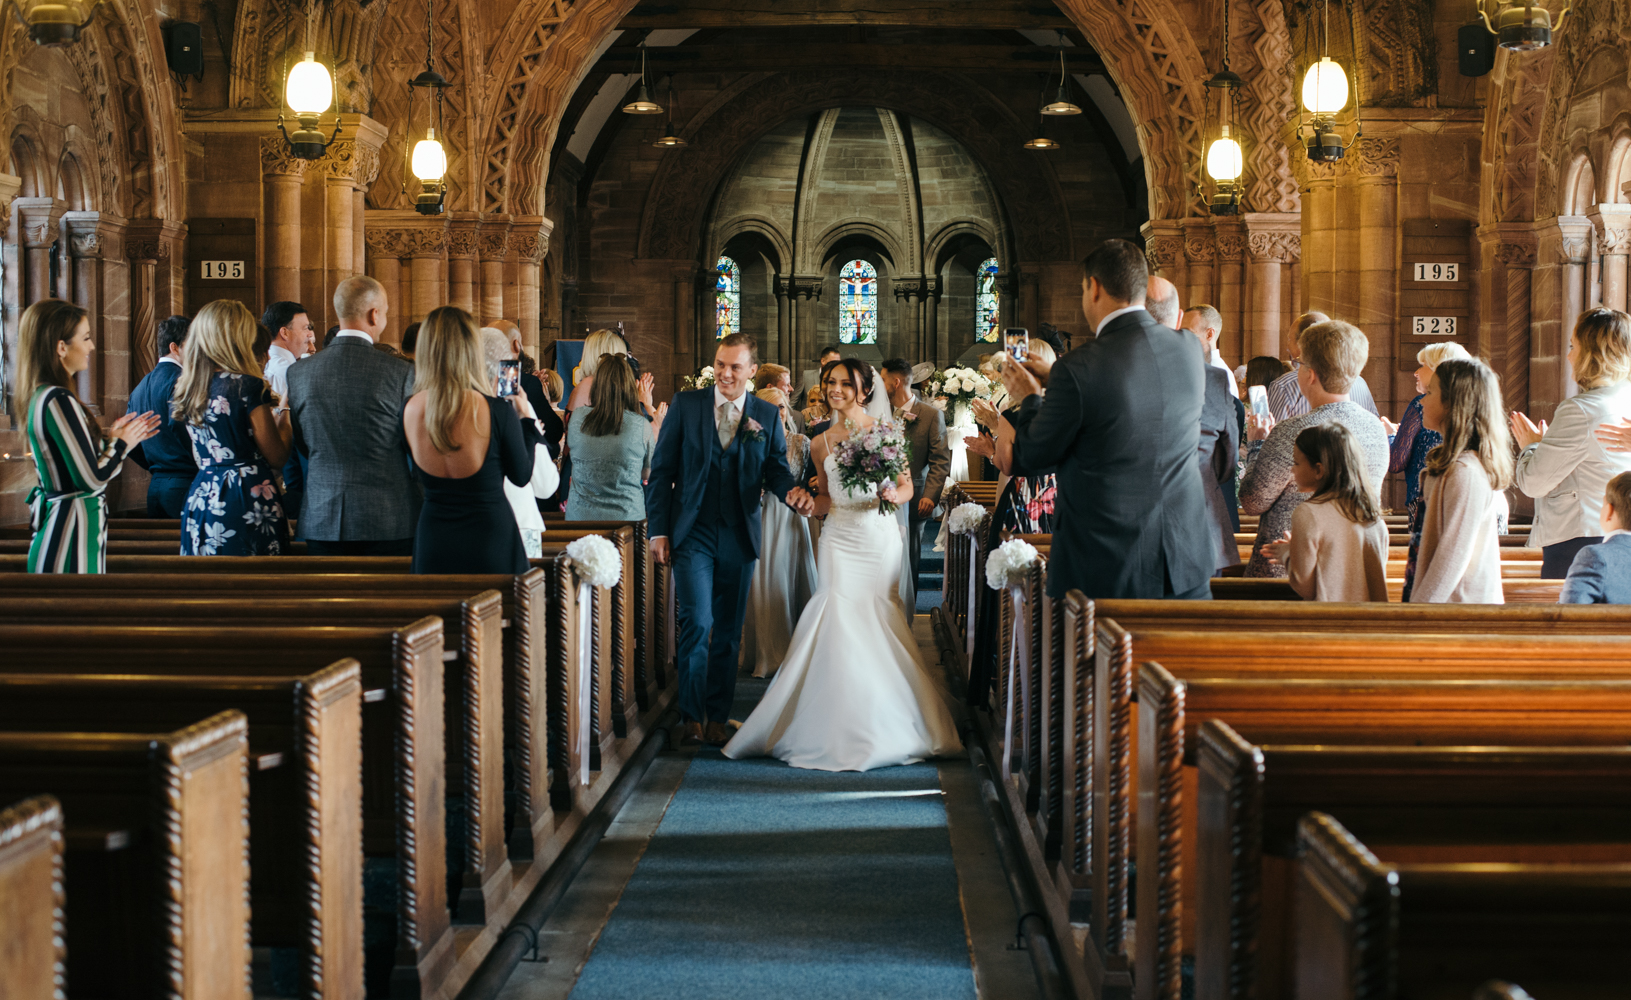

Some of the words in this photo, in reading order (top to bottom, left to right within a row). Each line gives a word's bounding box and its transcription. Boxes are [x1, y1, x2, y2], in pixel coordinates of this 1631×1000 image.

[205, 262, 241, 277] 195
[1419, 264, 1455, 280] 195
[1416, 318, 1454, 333] 523
